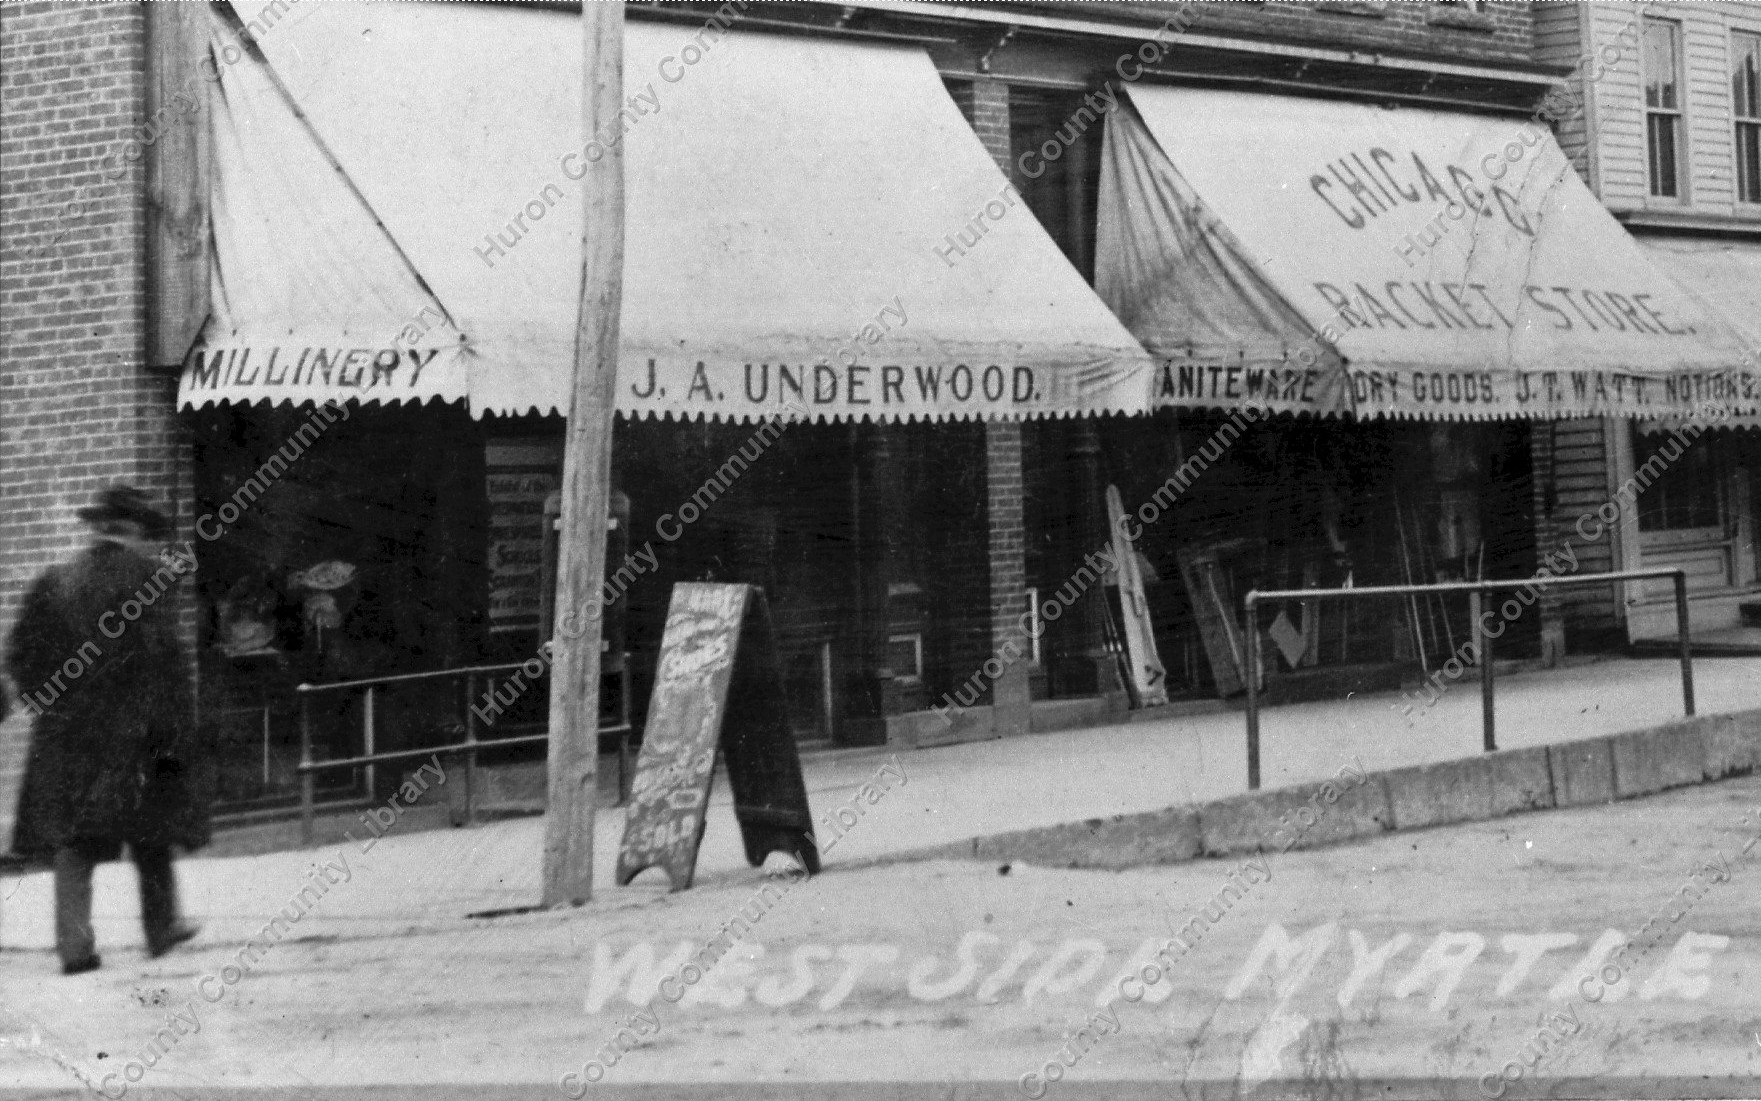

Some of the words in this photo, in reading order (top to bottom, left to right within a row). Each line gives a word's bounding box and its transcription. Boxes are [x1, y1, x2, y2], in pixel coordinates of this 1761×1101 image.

[190, 347, 438, 390] MILLINERY
[687, 361, 725, 401] A.
[743, 363, 1041, 404] UNDERWOOD.
[1160, 365, 1319, 402] ANITEWARE
[1352, 370, 1398, 404] DRY
